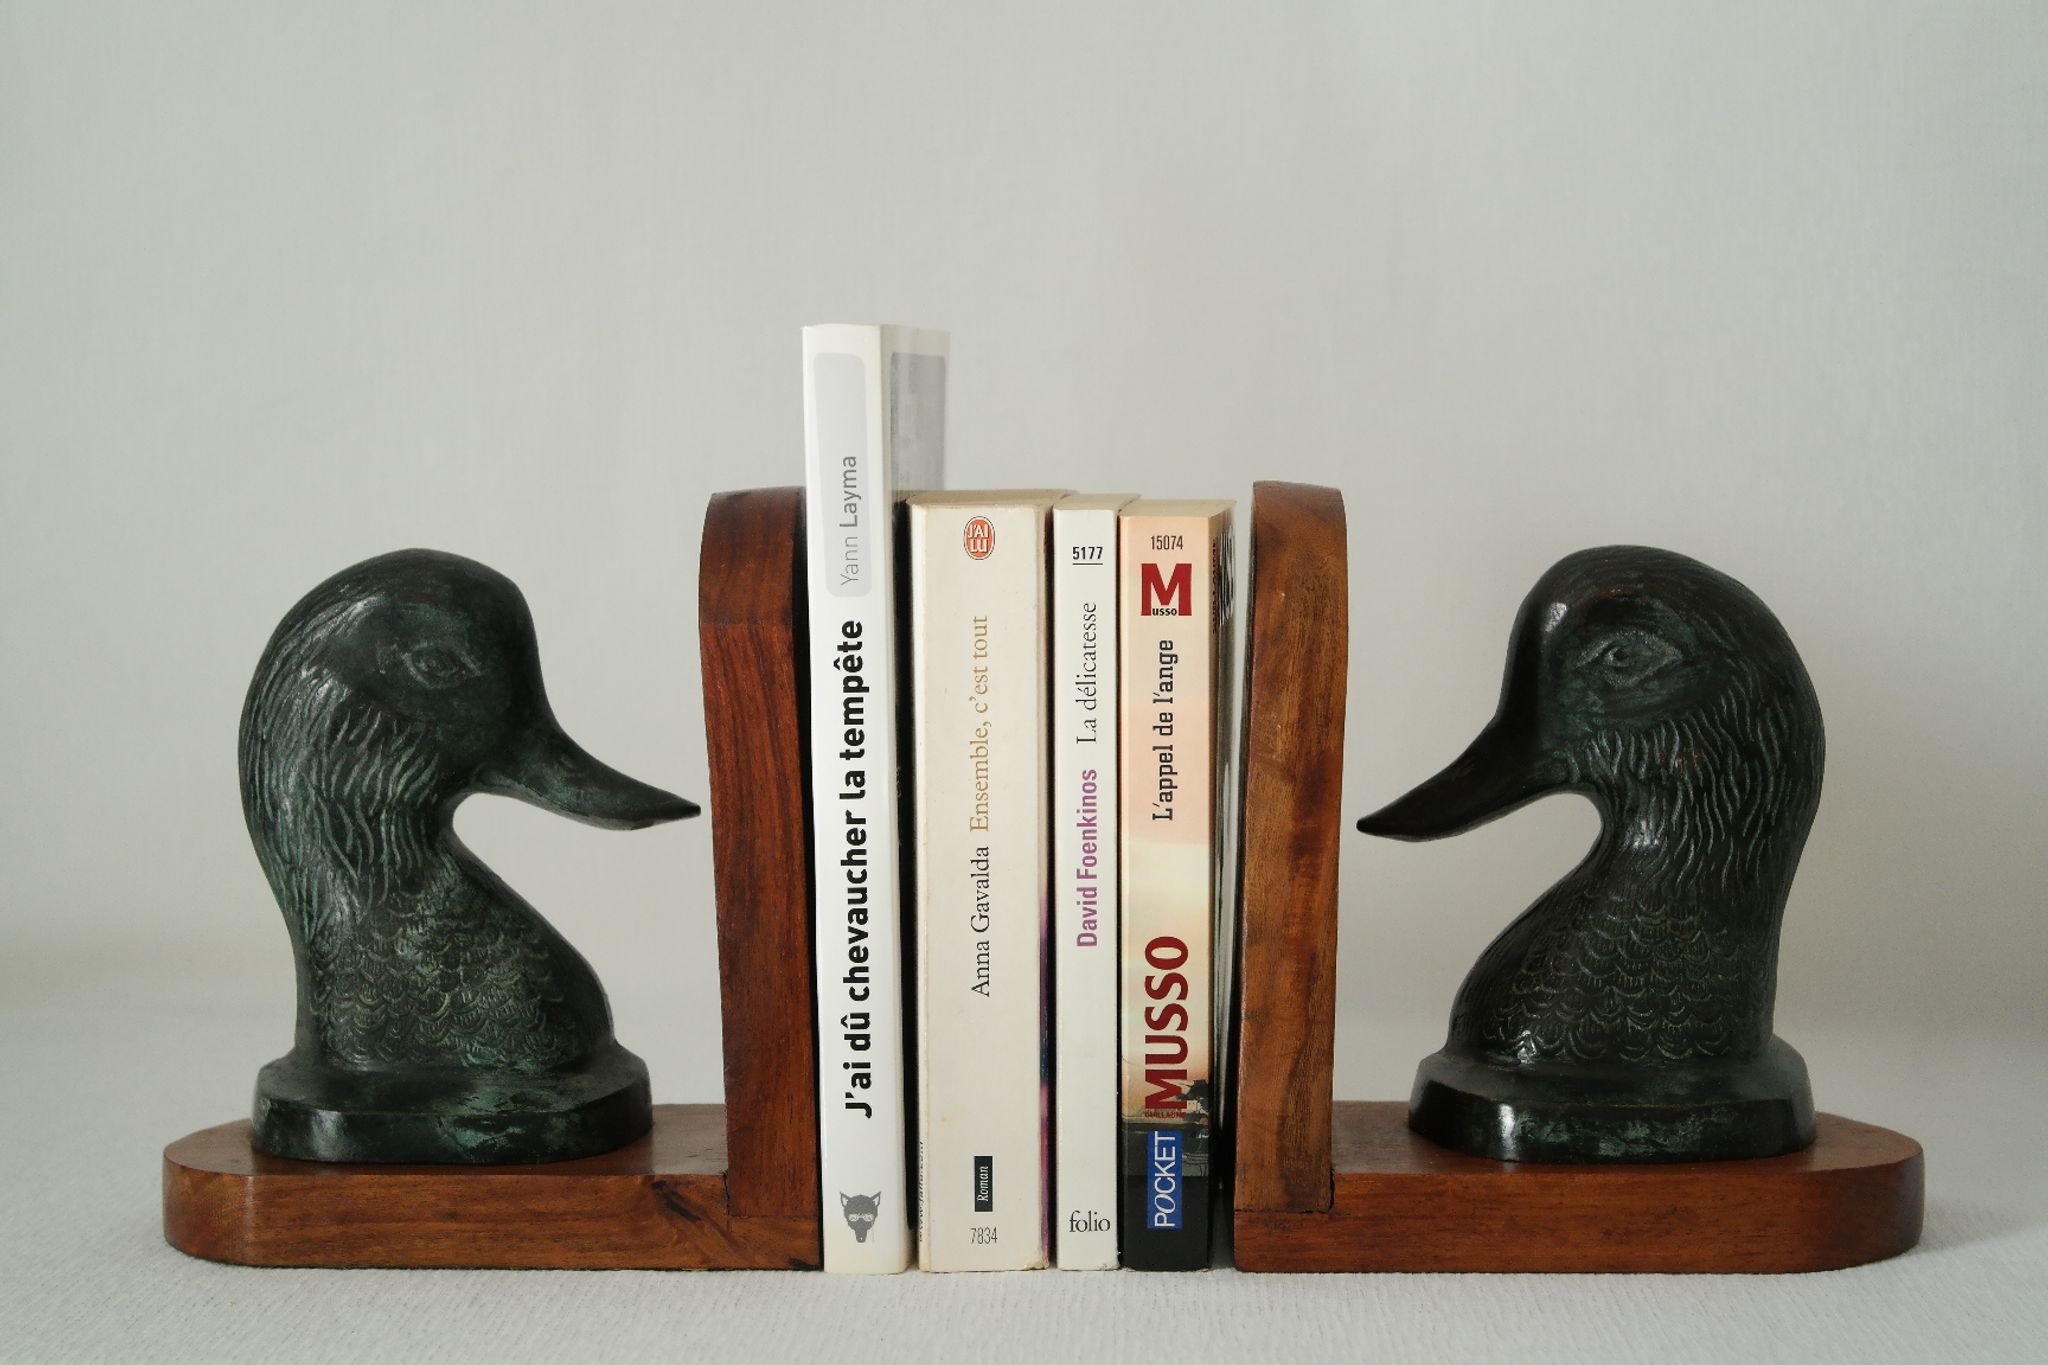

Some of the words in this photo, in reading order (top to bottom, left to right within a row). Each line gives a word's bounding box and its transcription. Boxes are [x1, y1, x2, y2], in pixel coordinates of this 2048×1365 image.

[839, 456, 862, 528] Layma
[967, 523, 989, 539] J'AI
[970, 539, 988, 554] LU
[1072, 546, 1104, 561] 5177
[1151, 535, 1184, 551] 15074
[841, 535, 860, 586] Yann
[972, 615, 990, 660] tout
[1074, 602, 1097, 711] délicatesse
[833, 620, 870, 761] tempête
[968, 665, 990, 714] c'est
[1152, 639, 1179, 705] l'ange
[1074, 717, 1097, 745] La
[1152, 712, 1174, 737] de
[838, 770, 867, 800] la
[968, 720, 992, 833] Ensemble,
[1152, 744, 1179, 821] L'appel
[1076, 769, 1098, 880] Foenkinos
[839, 809, 870, 1002] chevaucher
[969, 846, 990, 933] Gavalda
[1076, 886, 1098, 947] David
[970, 940, 990, 998] Anna
[840, 1011, 872, 1052] dû
[1144, 935, 1190, 1110] MUSSO
[843, 1061, 873, 1120] J'ai
[976, 1166, 990, 1202] Roman
[1153, 1132, 1178, 1228] POCKET
[970, 1226, 998, 1245] 7834
[1068, 1209, 1111, 1233] folio
